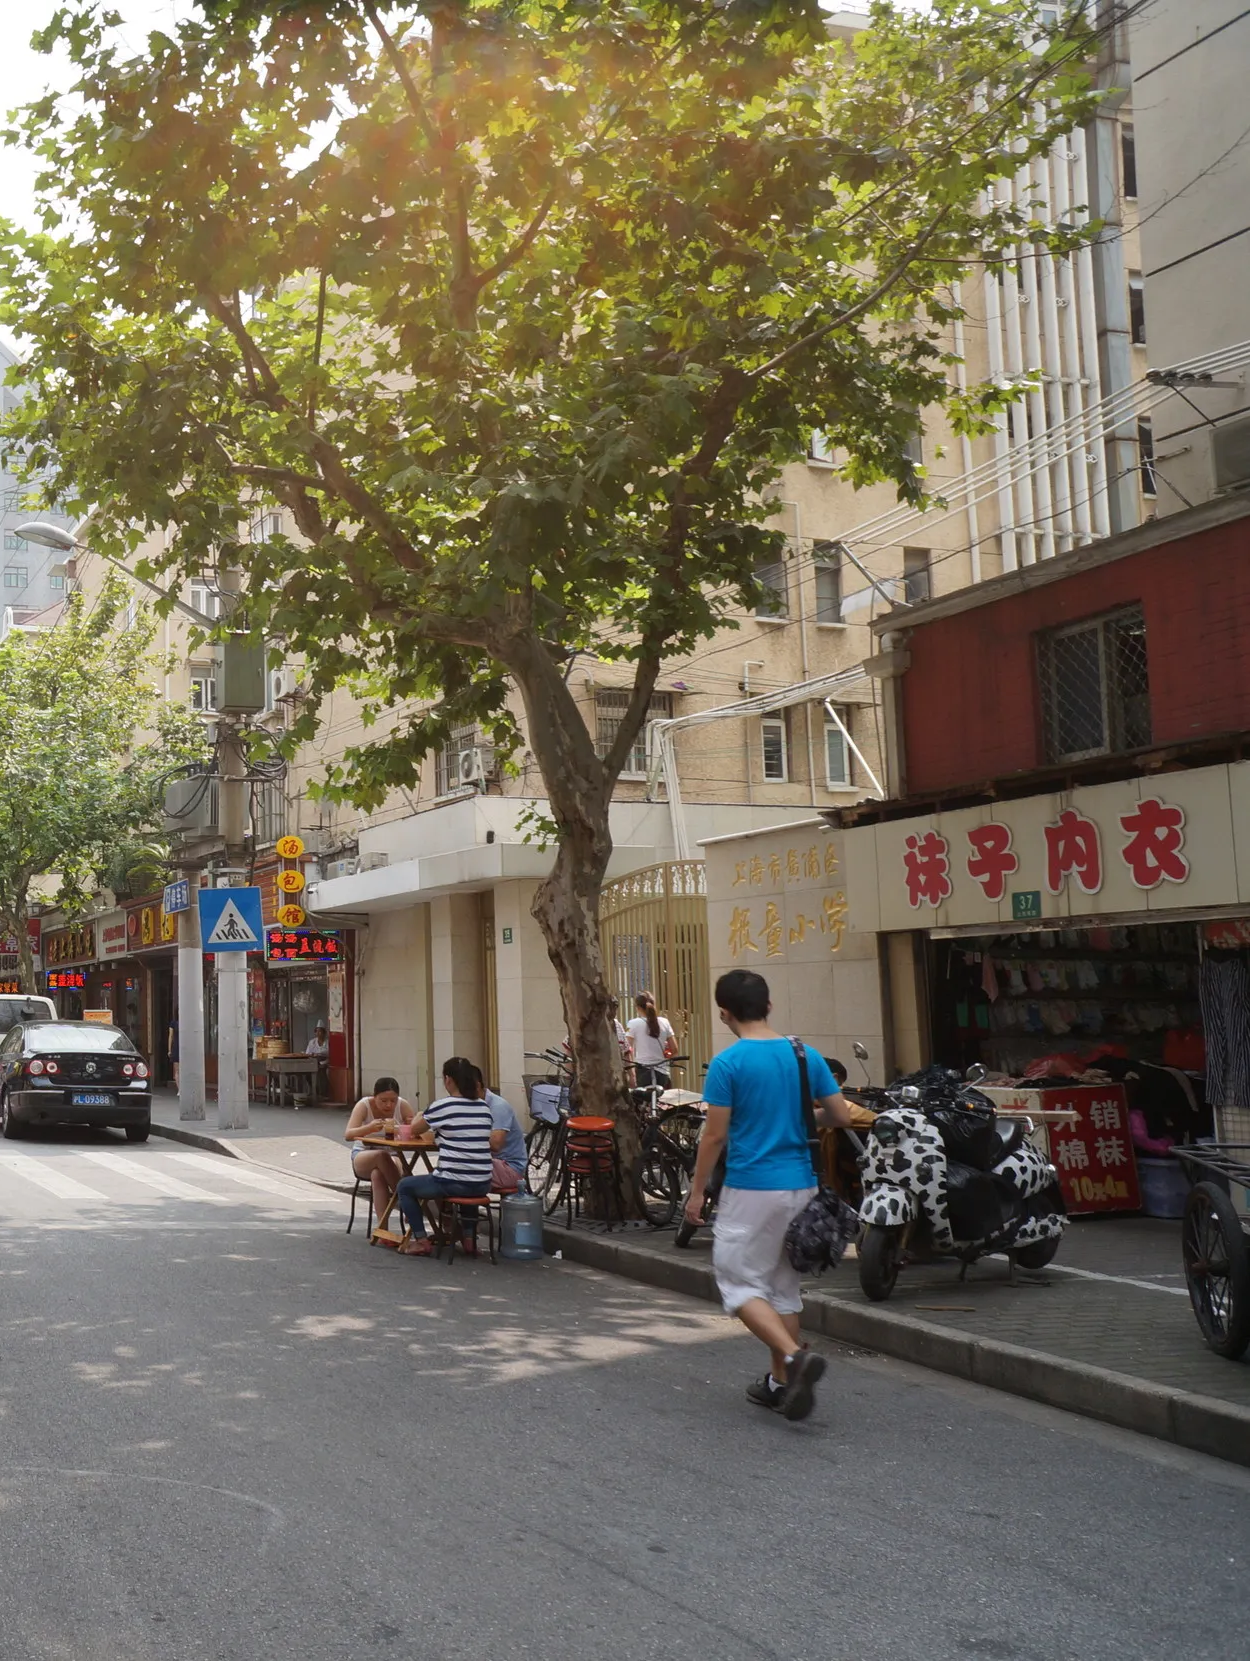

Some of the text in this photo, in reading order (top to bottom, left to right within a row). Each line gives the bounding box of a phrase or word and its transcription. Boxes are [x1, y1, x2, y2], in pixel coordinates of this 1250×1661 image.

[282, 839, 302, 924] 汤包馆
[903, 798, 1190, 908] 袜子内衣
[1018, 894, 1033, 910] 37
[1056, 1136, 1128, 1171] 棉袜
